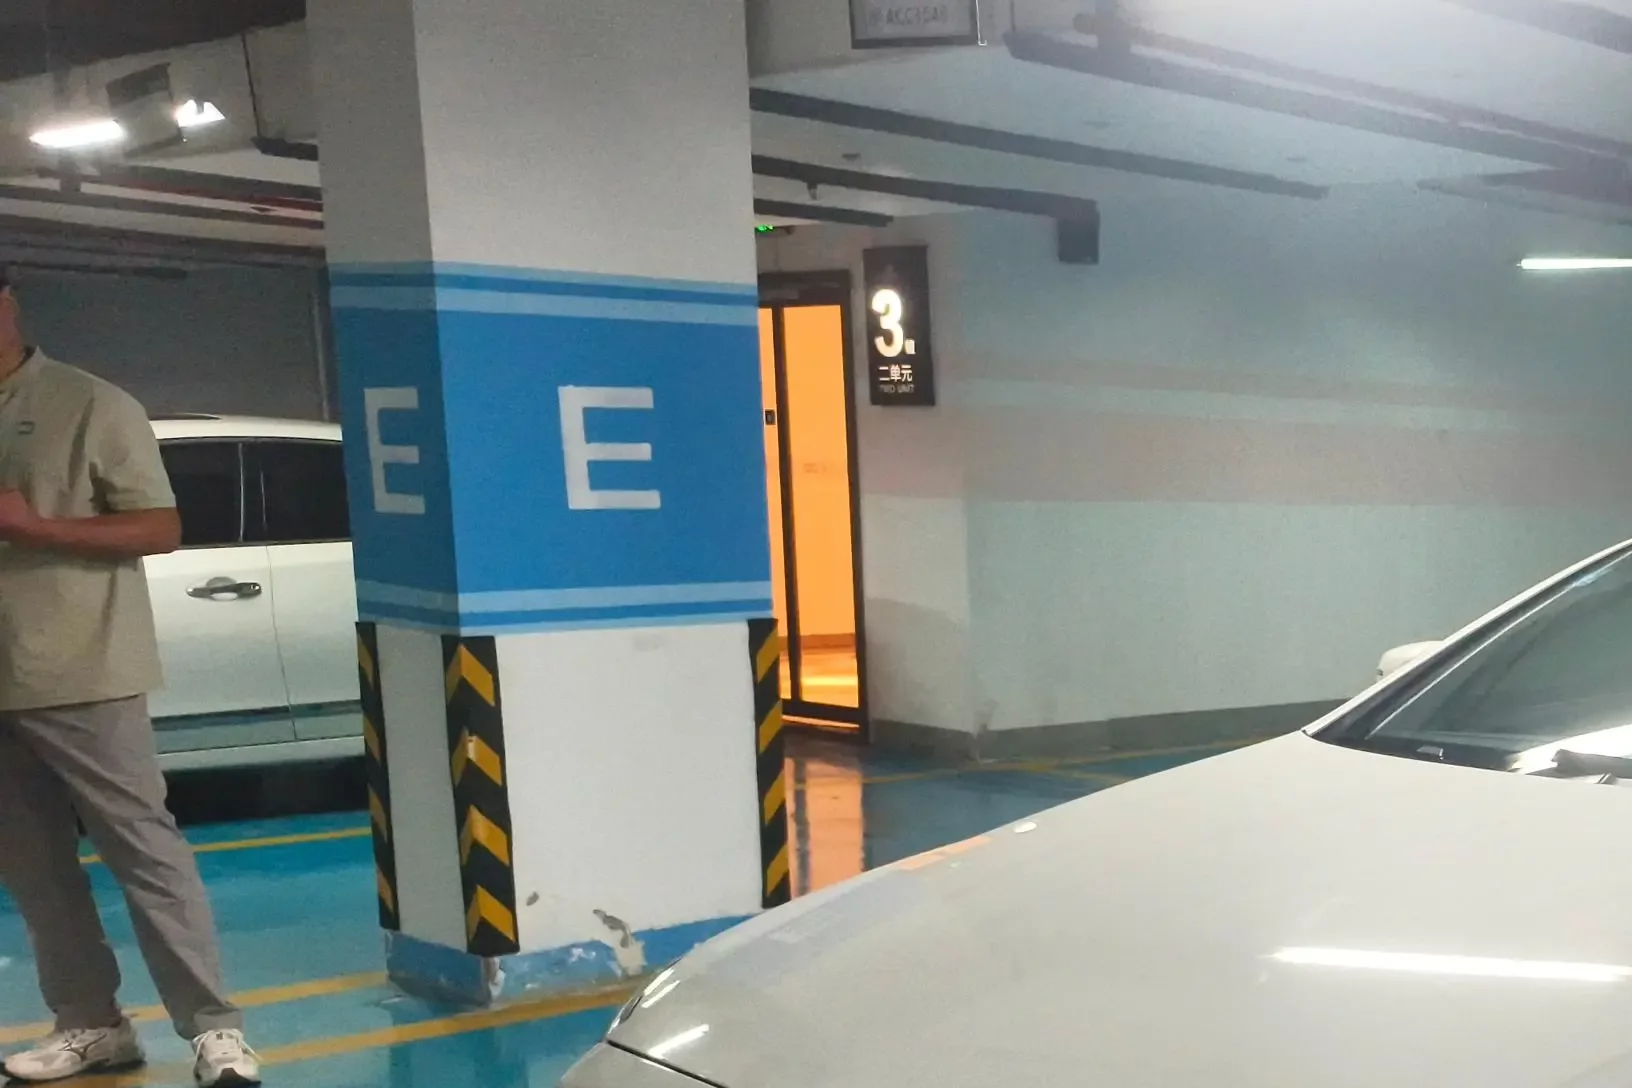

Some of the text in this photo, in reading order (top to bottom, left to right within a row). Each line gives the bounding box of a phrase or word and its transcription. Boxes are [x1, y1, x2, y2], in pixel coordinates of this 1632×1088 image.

[878, 364, 913, 382] 二单元
[363, 386, 425, 515] E
[557, 384, 661, 510] E
